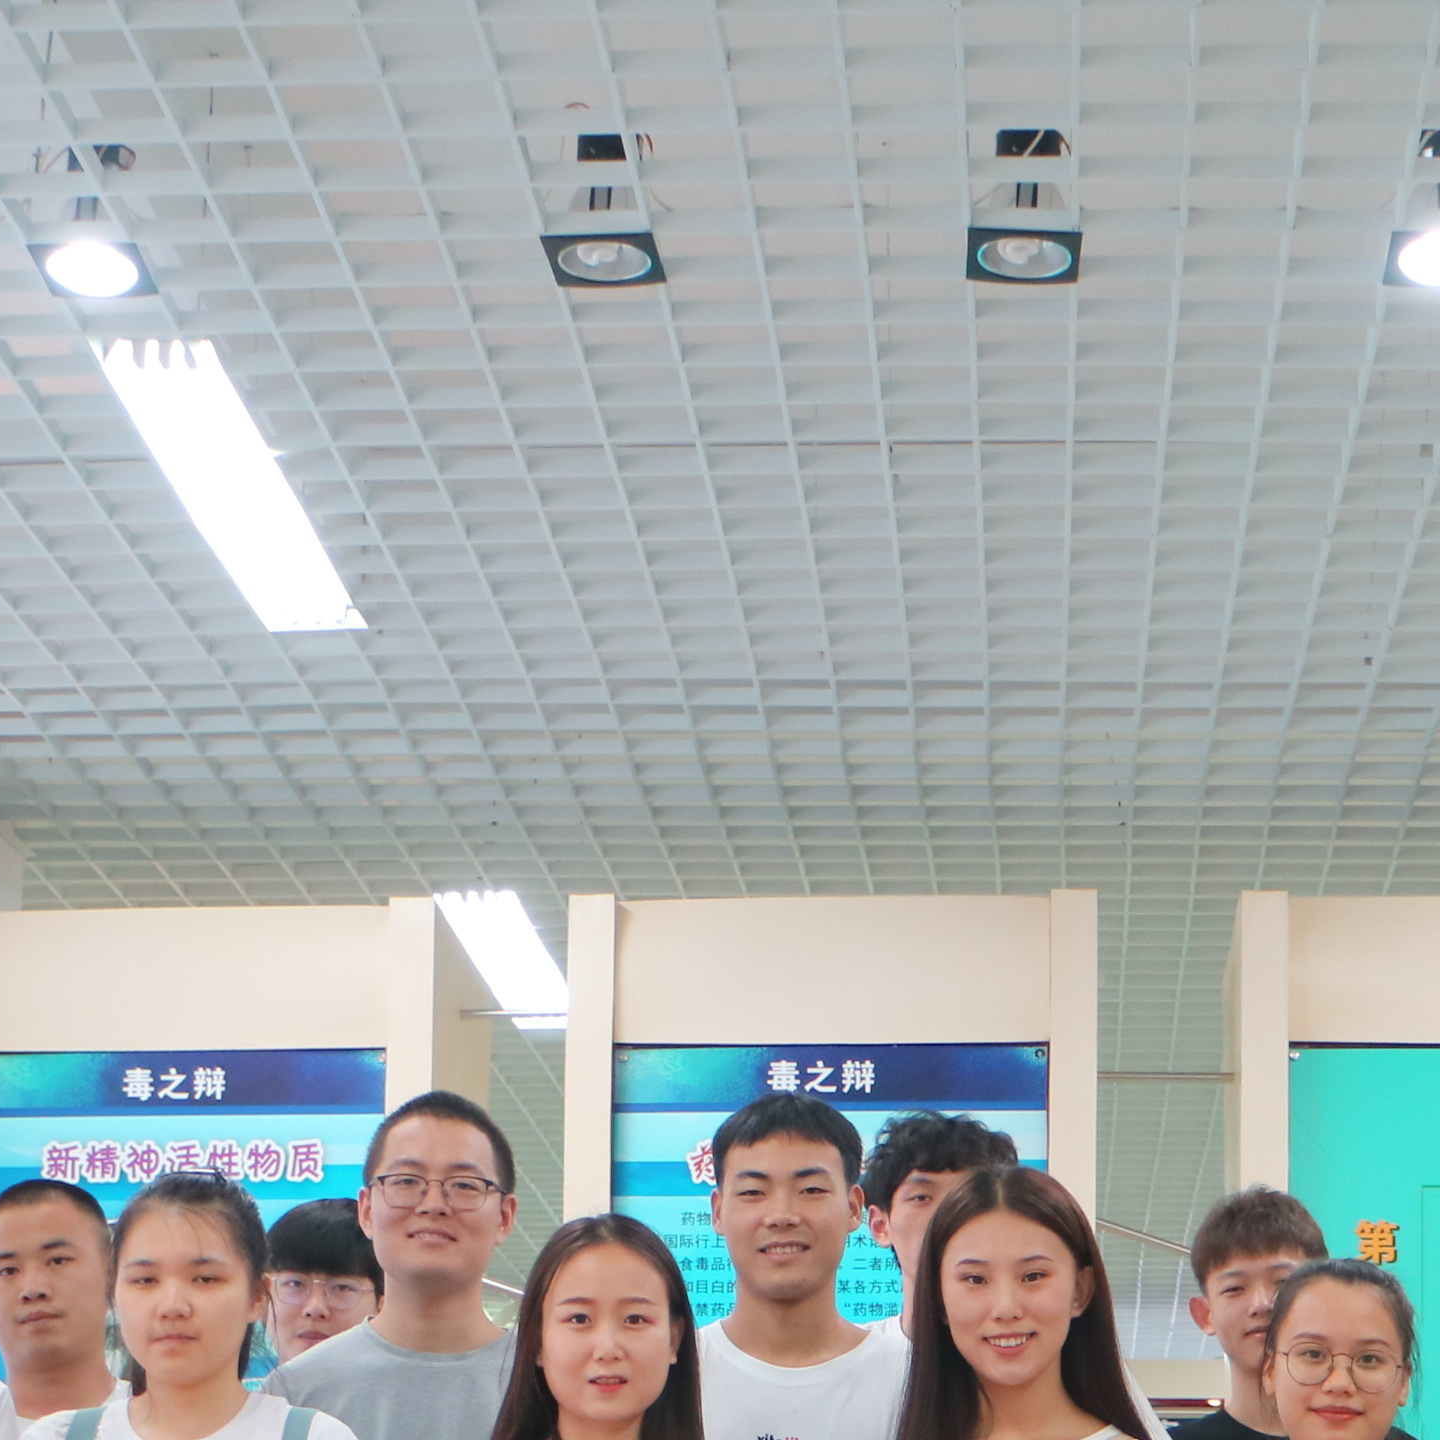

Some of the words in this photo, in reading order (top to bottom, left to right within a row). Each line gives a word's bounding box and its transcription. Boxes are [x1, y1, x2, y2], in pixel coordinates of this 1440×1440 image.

[122, 1067, 227, 1102] 毒之辩
[766, 1060, 876, 1094] 毒之辩
[45, 1141, 324, 1182] 新精神活性物质
[1354, 1220, 1400, 1265] 第
[837, 1279, 903, 1295] 某各方式
